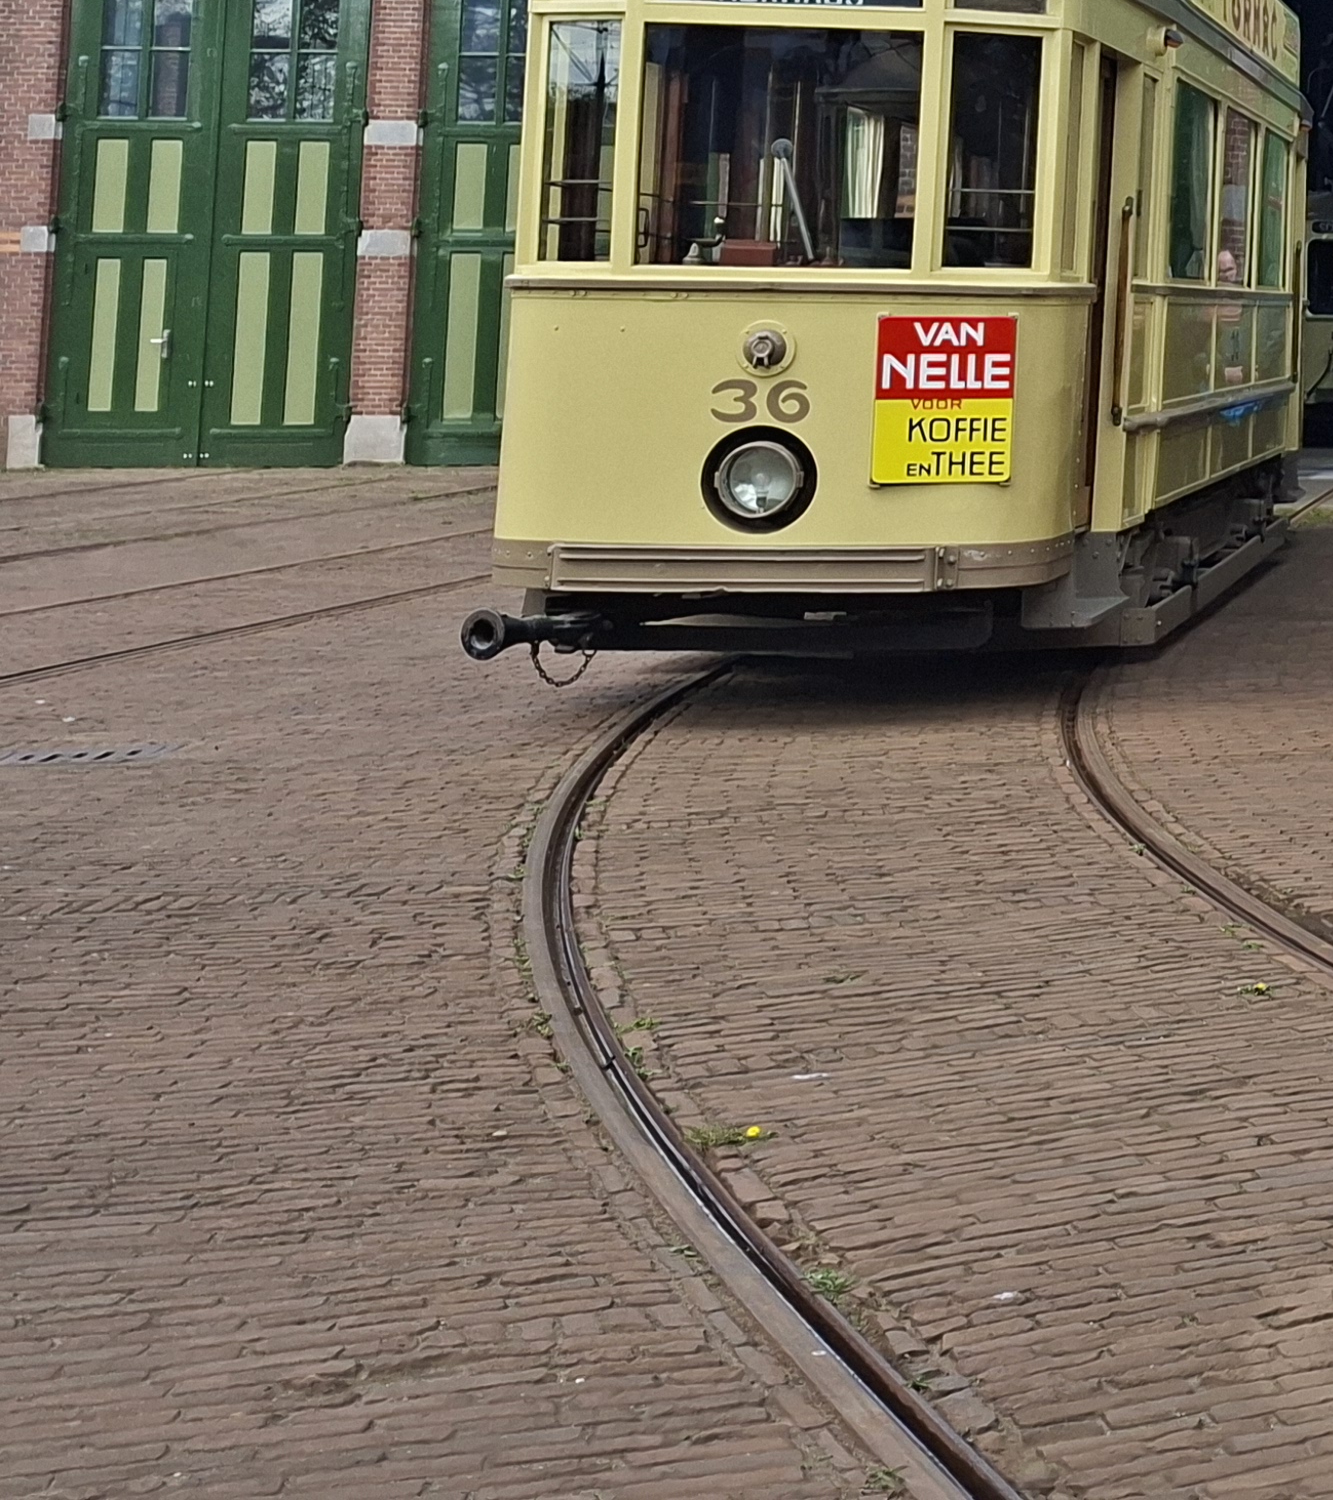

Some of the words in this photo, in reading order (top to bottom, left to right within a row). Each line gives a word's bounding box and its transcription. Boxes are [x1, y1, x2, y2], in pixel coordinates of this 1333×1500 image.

[913, 322, 986, 347] VAN
[881, 353, 1011, 390] NELLE
[710, 378, 811, 424] 36
[911, 399, 962, 410] VOOR
[908, 417, 1007, 443] KOFFIE
